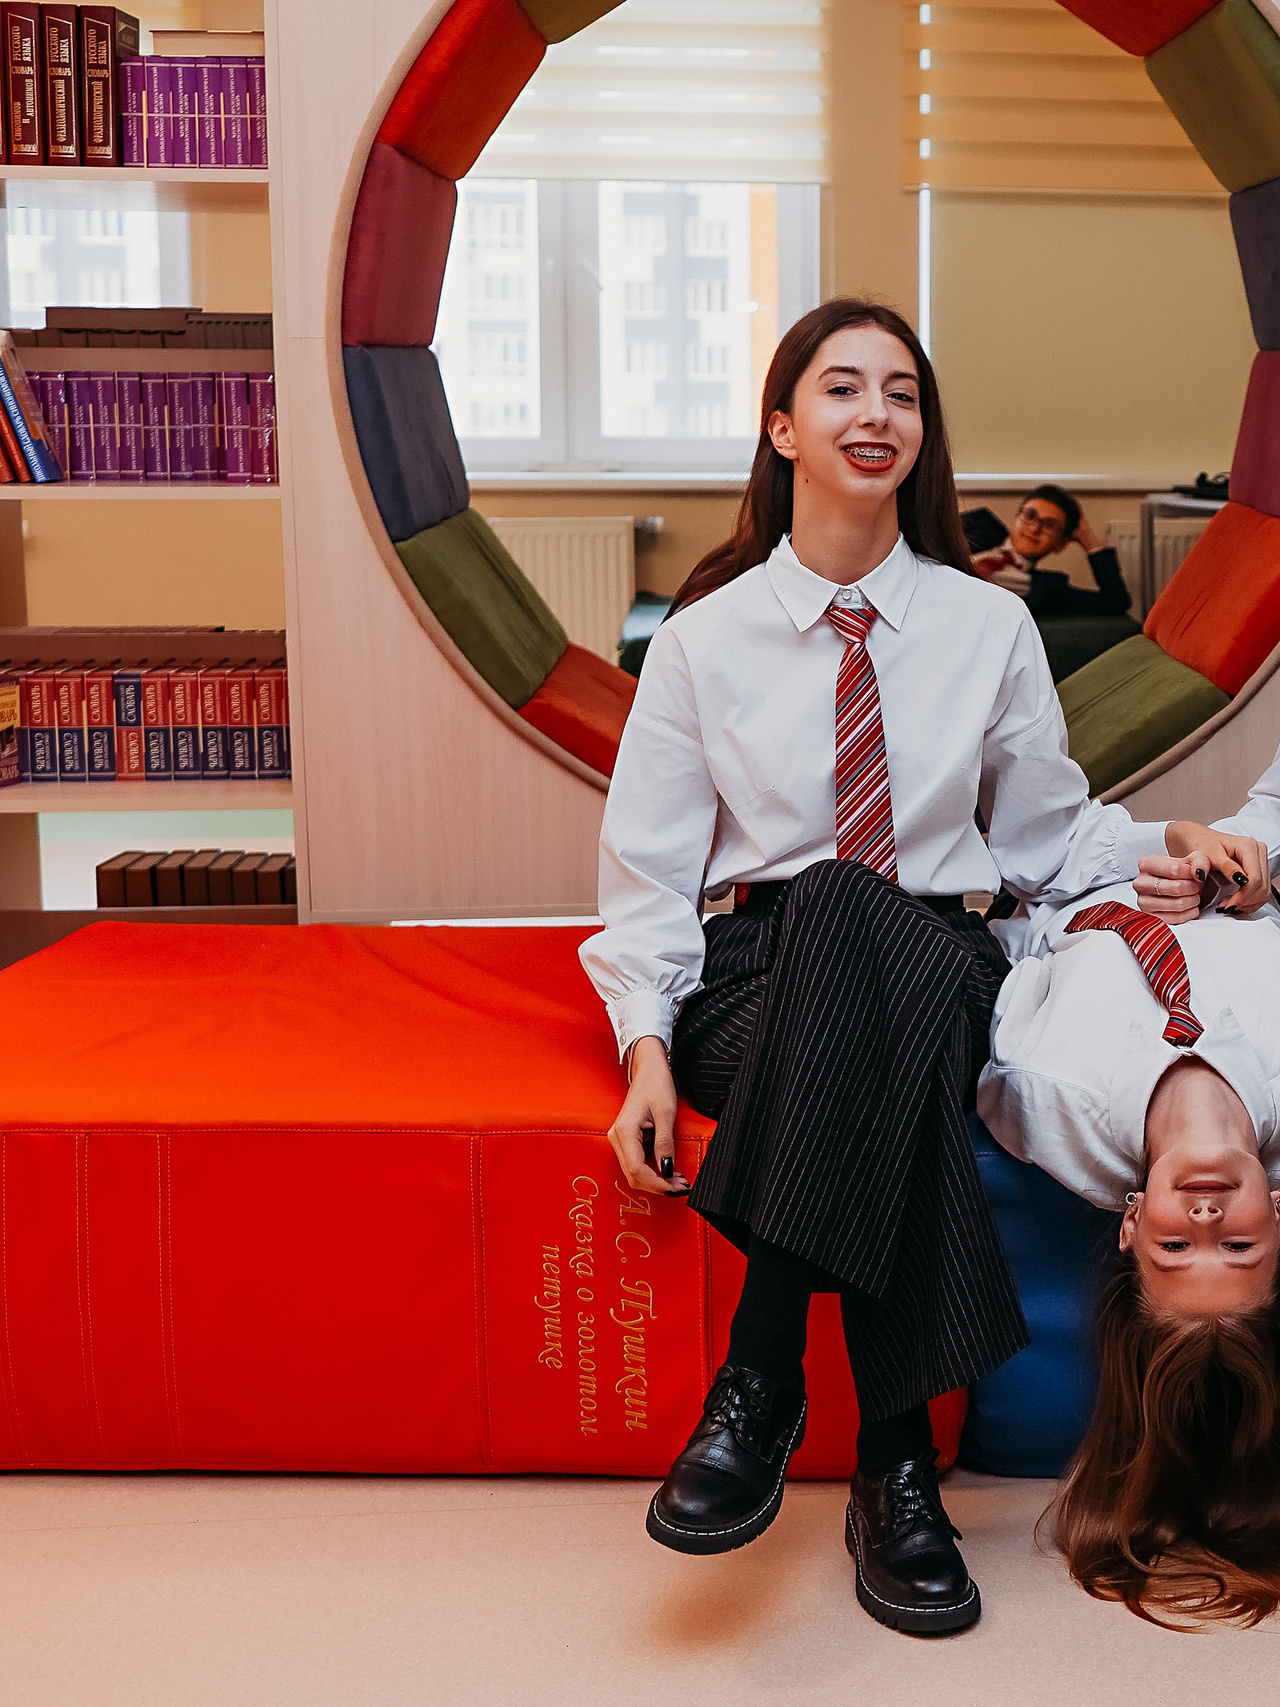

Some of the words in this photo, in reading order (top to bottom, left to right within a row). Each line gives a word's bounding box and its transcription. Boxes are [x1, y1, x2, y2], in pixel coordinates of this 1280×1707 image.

[12, 26, 21, 61] РУССКОГО
[22, 37, 31, 62] ЯЗЫКА
[49, 27, 59, 63] РУССКОГО
[60, 38, 70, 63] ЯЗЫКА
[88, 29, 98, 64] РУССКОГО
[98, 40, 107, 65] ЯЗЫКА
[32, 685, 42, 722] СЛОВАРЬ
[60, 685, 70, 722] СЛОВАРЬ
[90, 684, 101, 722] СЛОВАРЬ
[126, 684, 137, 722] СЛОВАРЬ
[146, 684, 156, 721] СЛОВАРЬ
[175, 683, 185, 720] СЛОВАРЬ
[204, 683, 214, 721] СЛОВАРЬ
[231, 683, 242, 721] СЛОВАРЬ
[260, 683, 270, 720] СЛОВАРЬ
[34, 732, 46, 770] СЛОВАРЬ
[63, 732, 74, 770] СЛОВАРЬ
[92, 731, 104, 770] СЛОВАРЬ
[128, 732, 140, 769] СЛОВАРЬ
[149, 731, 160, 770] СЛОВАРЬ
[177, 730, 189, 769] СЛОВАРЬ
[206, 730, 218, 769] СЛОВАРЬ
[234, 730, 245, 769] СЛОВАРЬ
[262, 730, 274, 768] СЛОВАРЬ
[568, 1175, 599, 1279] Сказка
[533, 1244, 564, 1370] петушке
[576, 1287, 594, 1303] о
[609, 1277, 658, 1431] Пушкин
[576, 1311, 598, 1437] золотом
